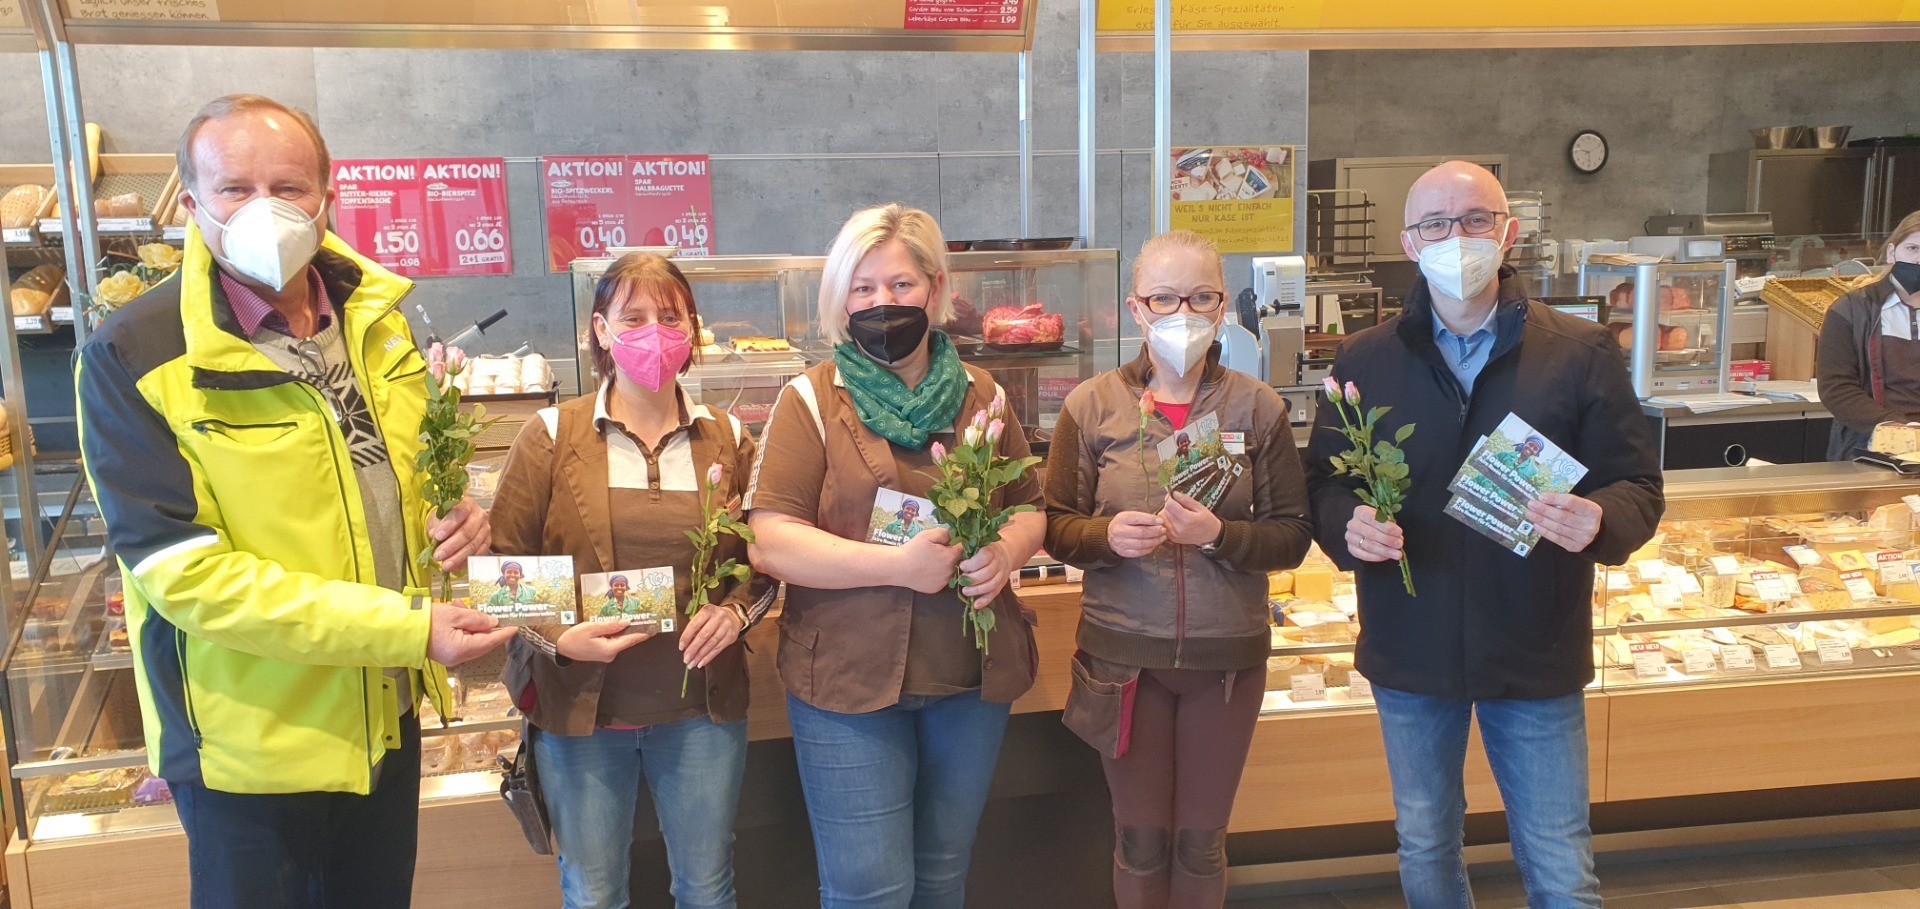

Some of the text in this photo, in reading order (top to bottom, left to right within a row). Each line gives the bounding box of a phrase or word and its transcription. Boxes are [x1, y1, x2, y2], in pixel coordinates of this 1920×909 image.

[80, 9, 107, 18] Brot
[1001, 16, 1017, 24] 1.99
[1172, 19, 1191, 29] für
[1197, 19, 1213, 28] Sie
[1217, 17, 1281, 30] ausgewählt
[336, 165, 415, 180] AKTION!
[423, 163, 501, 179] AKTION!
[547, 161, 623, 177] AKTION!
[632, 160, 706, 176] AKTION!
[341, 197, 392, 205] TOPFENTASCHE
[1208, 203, 1232, 212] NICHT
[1237, 202, 1272, 211] EINFACH
[1191, 214, 1209, 223] NUR
[1241, 213, 1255, 222] IST
[373, 231, 419, 254] 1.50
[455, 228, 504, 252] 0.66
[581, 226, 626, 249] 0.40
[664, 224, 708, 247] 0.49
[400, 258, 420, 267] 0.98
[462, 255, 479, 263] 2+1
[1481, 450, 1511, 474] Flower
[1460, 474, 1490, 495] Flower
[1455, 496, 1486, 518] Flower
[873, 528, 901, 542] Flower
[1877, 553, 1903, 562] AKTION
[1751, 573, 1780, 581] AKTION
[477, 603, 513, 613] Flower
